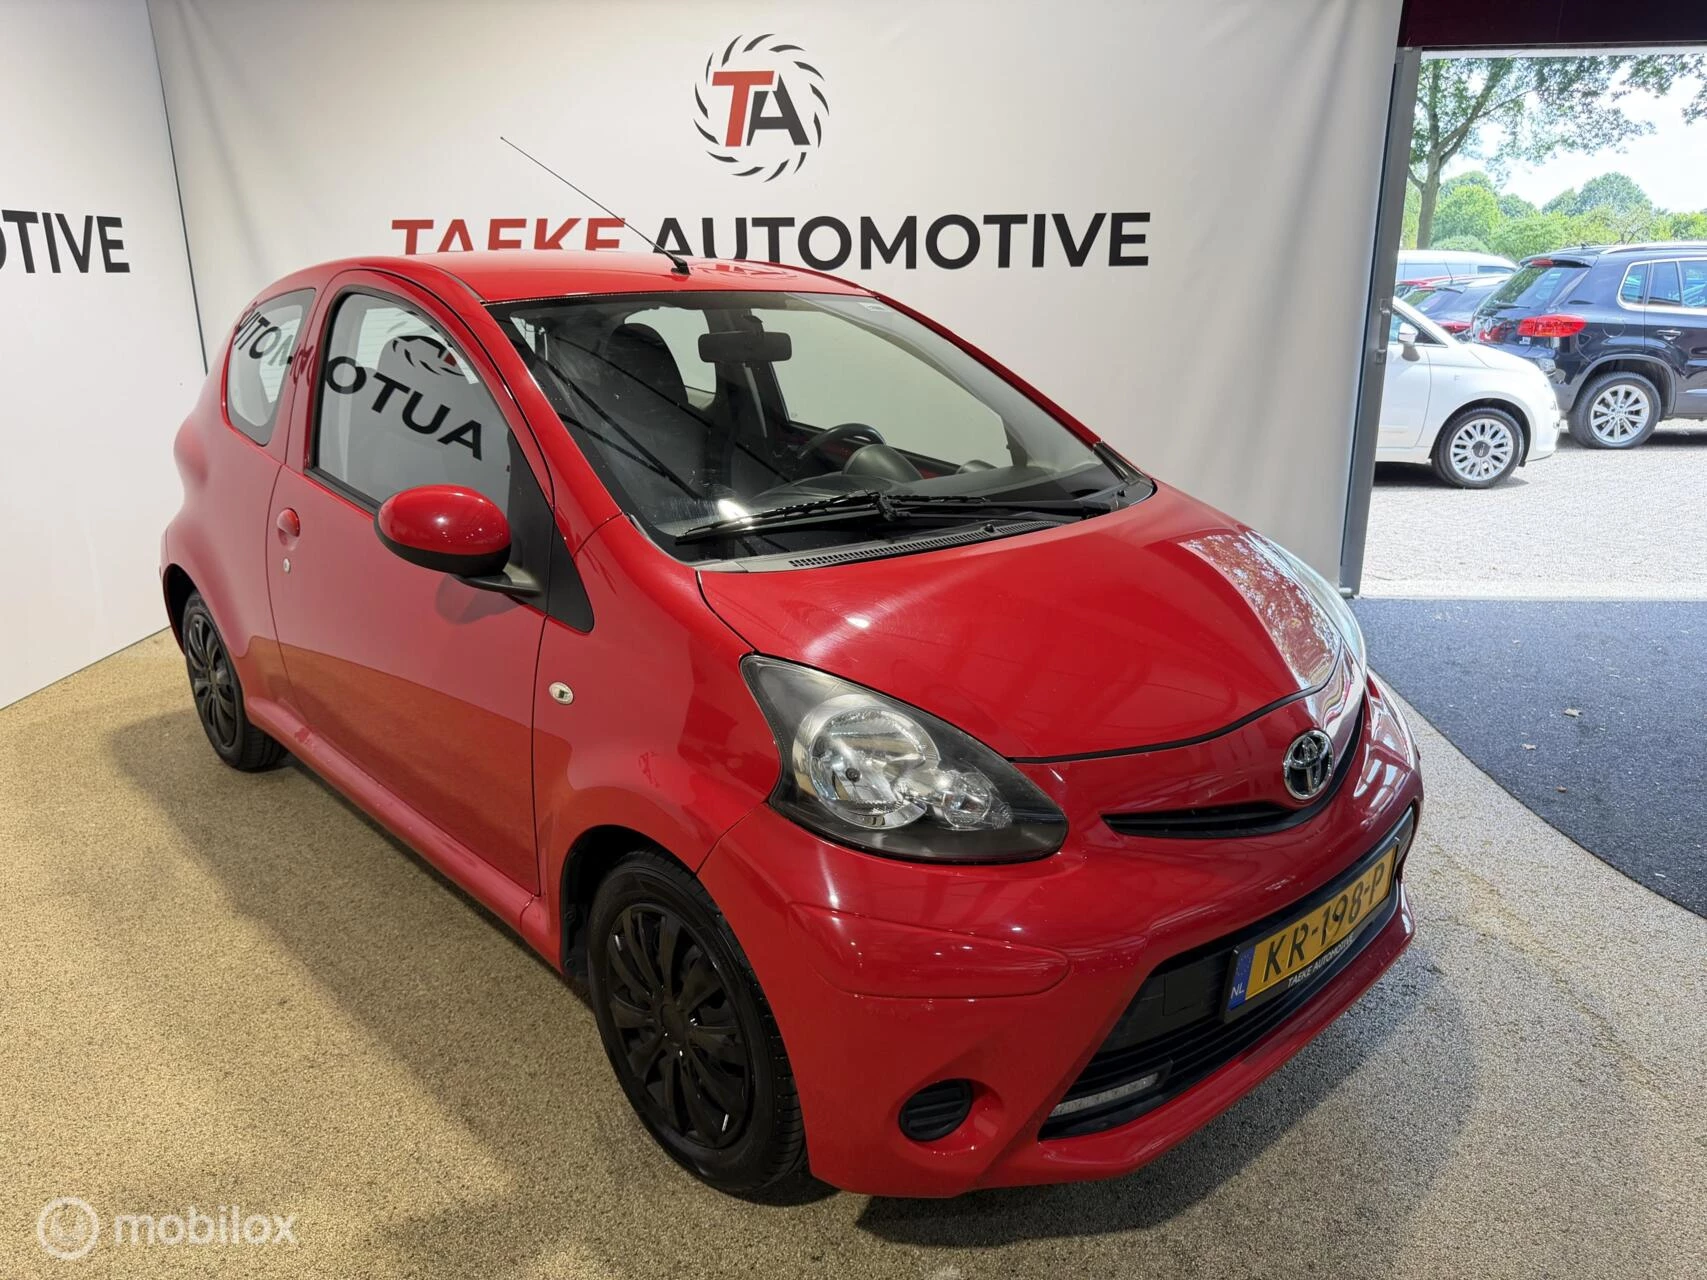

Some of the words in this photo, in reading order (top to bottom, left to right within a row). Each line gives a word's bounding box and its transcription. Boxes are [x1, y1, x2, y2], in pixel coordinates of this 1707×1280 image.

[712, 71, 811, 147] TA
[0, 210, 130, 273] TIVE
[653, 212, 1150, 269] AUTOMOTIVE
[1262, 862, 1385, 984] KR-198-P
[1230, 983, 1245, 999] NL
